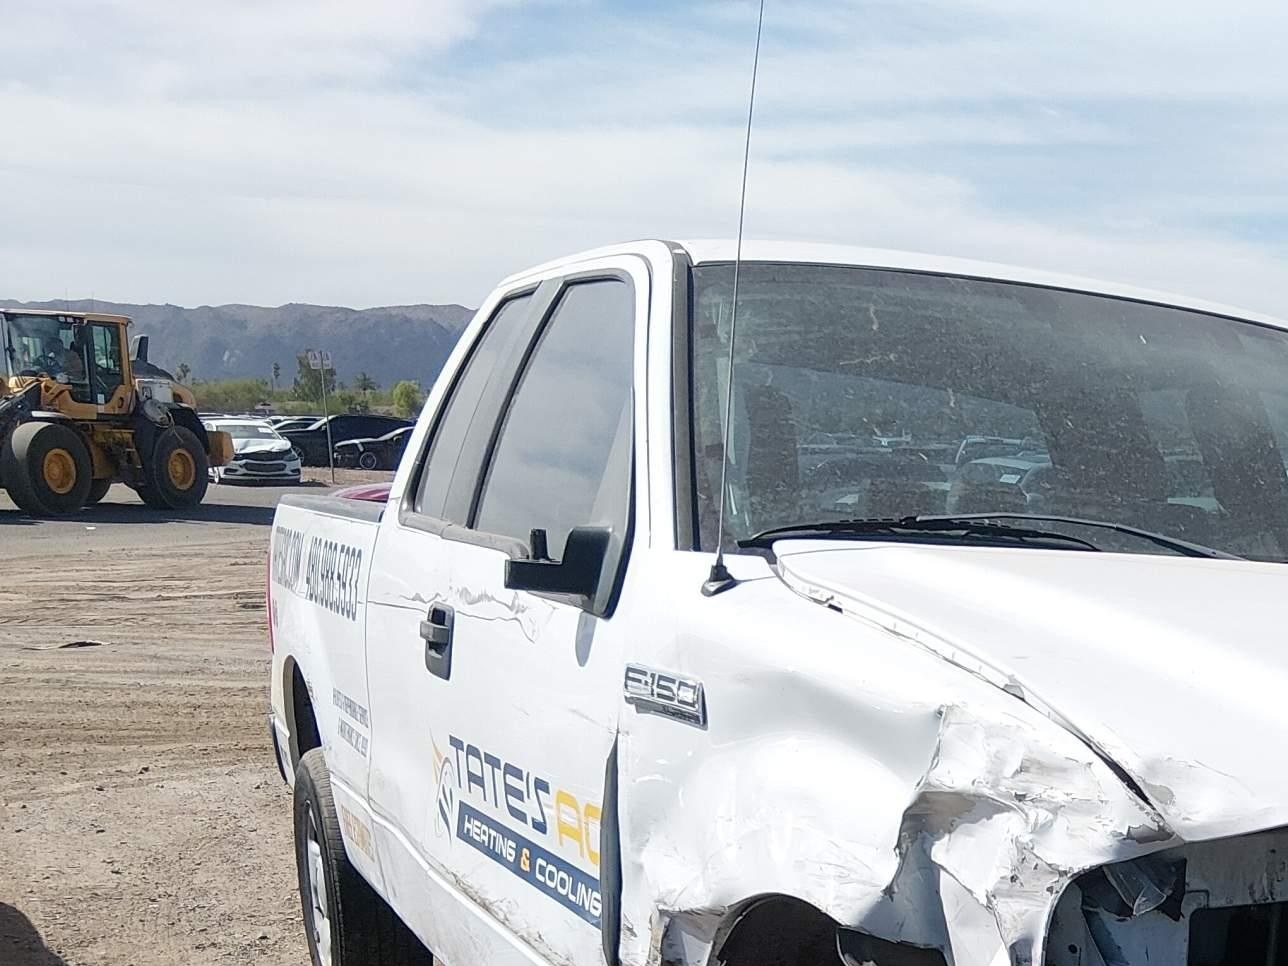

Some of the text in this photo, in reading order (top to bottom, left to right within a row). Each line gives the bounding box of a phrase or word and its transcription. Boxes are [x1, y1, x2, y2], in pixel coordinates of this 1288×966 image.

[304, 535, 363, 622] 480.988.5933
[624, 666, 699, 709] F-150
[449, 734, 551, 835] TATE'S
[463, 814, 602, 918] HEATING & COOLING
